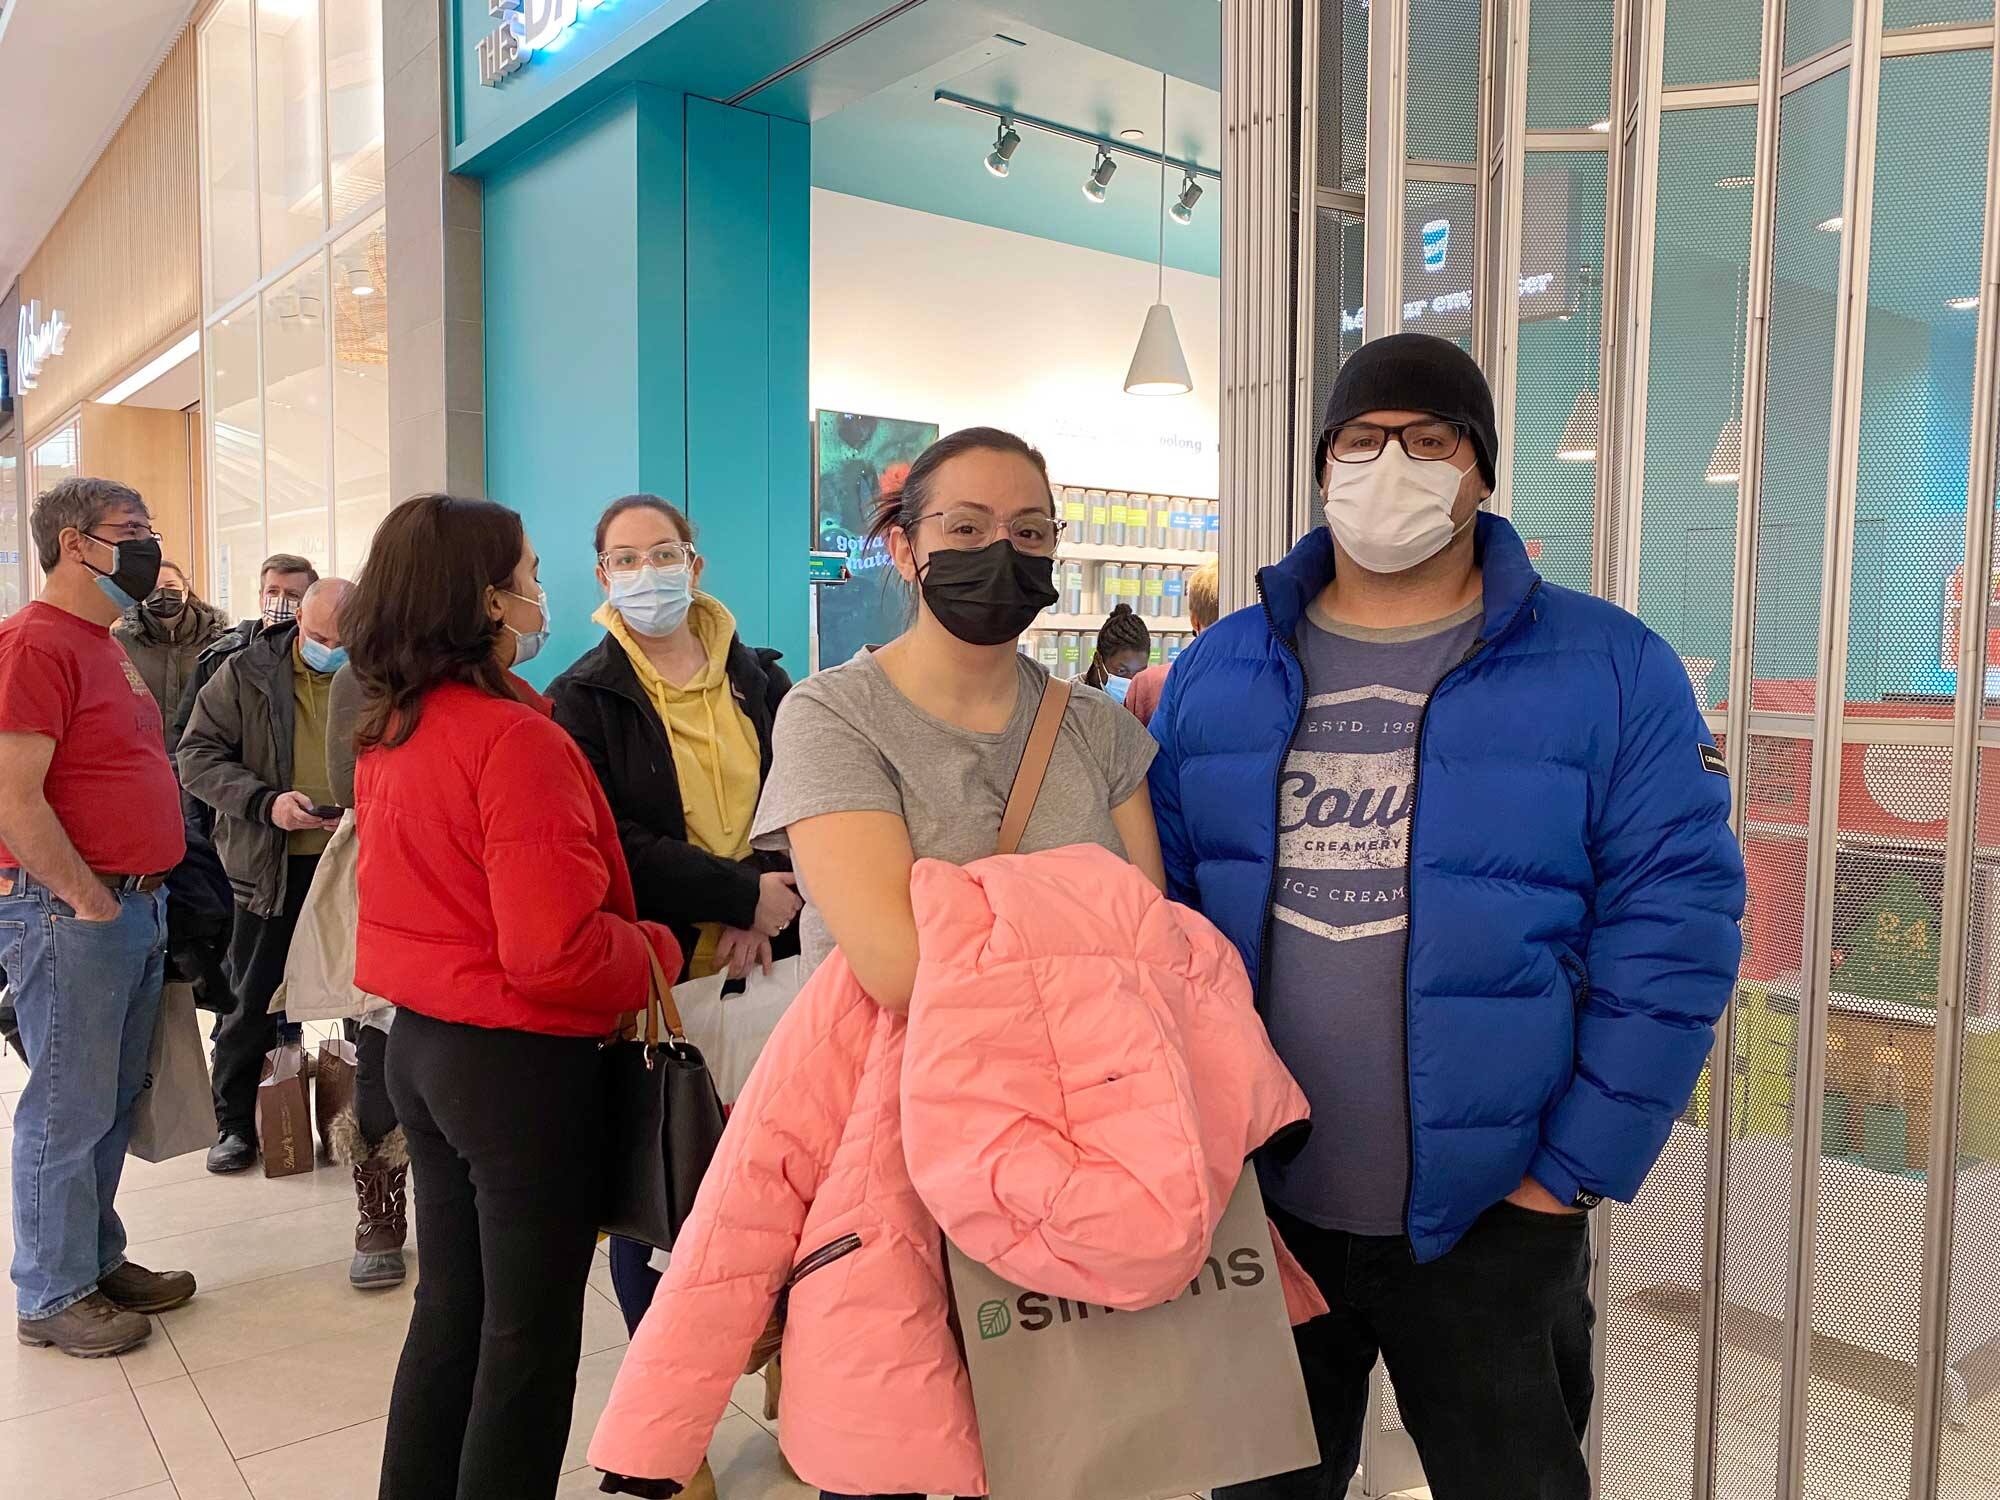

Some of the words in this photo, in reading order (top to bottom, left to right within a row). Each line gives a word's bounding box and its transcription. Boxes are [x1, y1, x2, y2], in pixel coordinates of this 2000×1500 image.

[1160, 433, 1202, 455] oolong
[1308, 721, 1370, 733] ESTD.
[1381, 722, 1416, 734] 198
[1279, 771, 1416, 833] Cow
[1304, 838, 1402, 851] CREAMERY
[1282, 878, 1319, 898] ICE
[1328, 887, 1406, 902] CREAM
